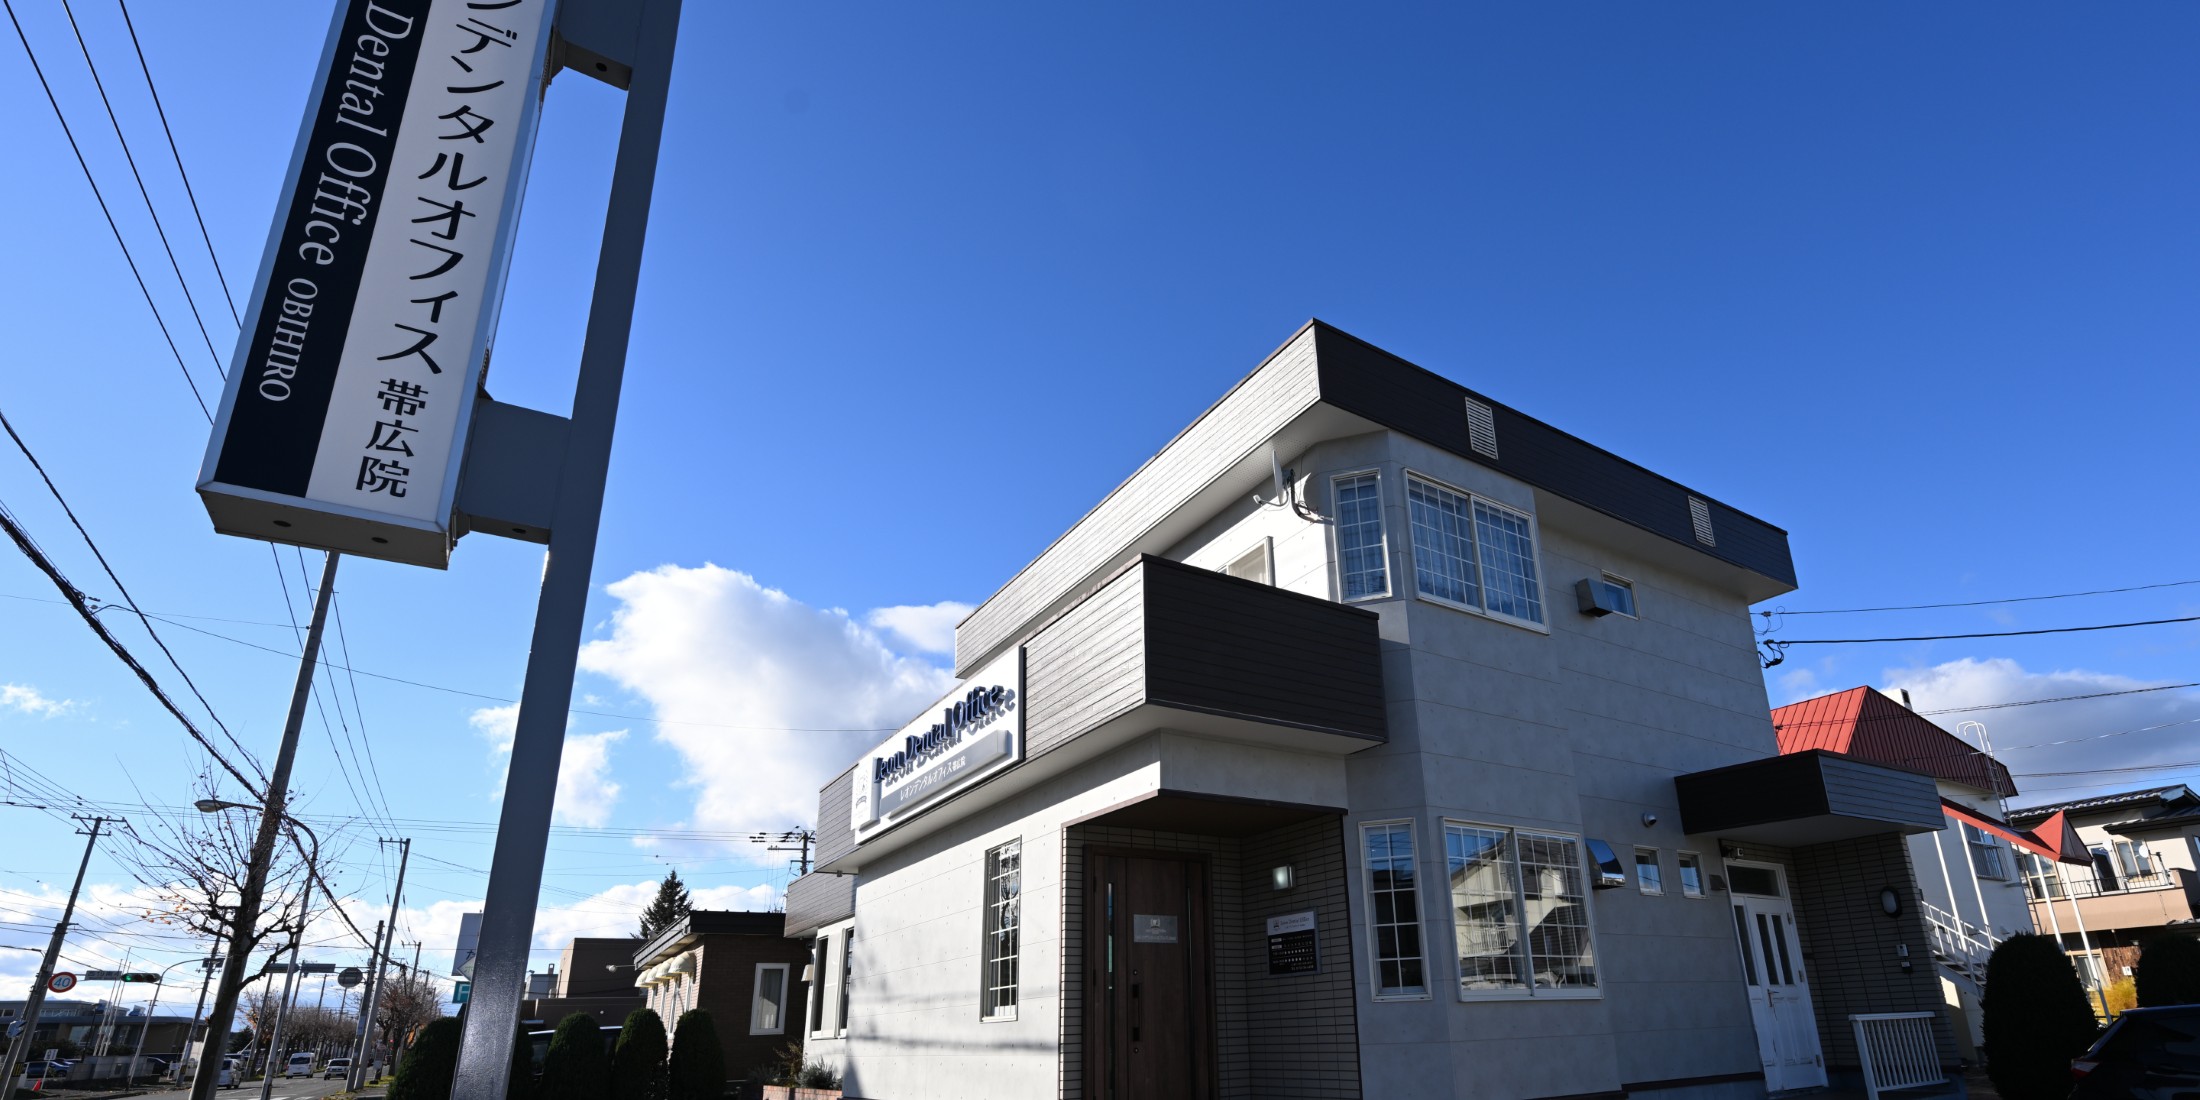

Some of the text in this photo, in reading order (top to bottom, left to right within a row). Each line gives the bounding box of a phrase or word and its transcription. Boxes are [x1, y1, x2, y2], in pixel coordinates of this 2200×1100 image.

[259, 0, 414, 402] Dental Office OBIHIRO
[905, 708, 953, 761] Dental
[952, 685, 1005, 730] Office
[54, 977, 71, 988] 40
